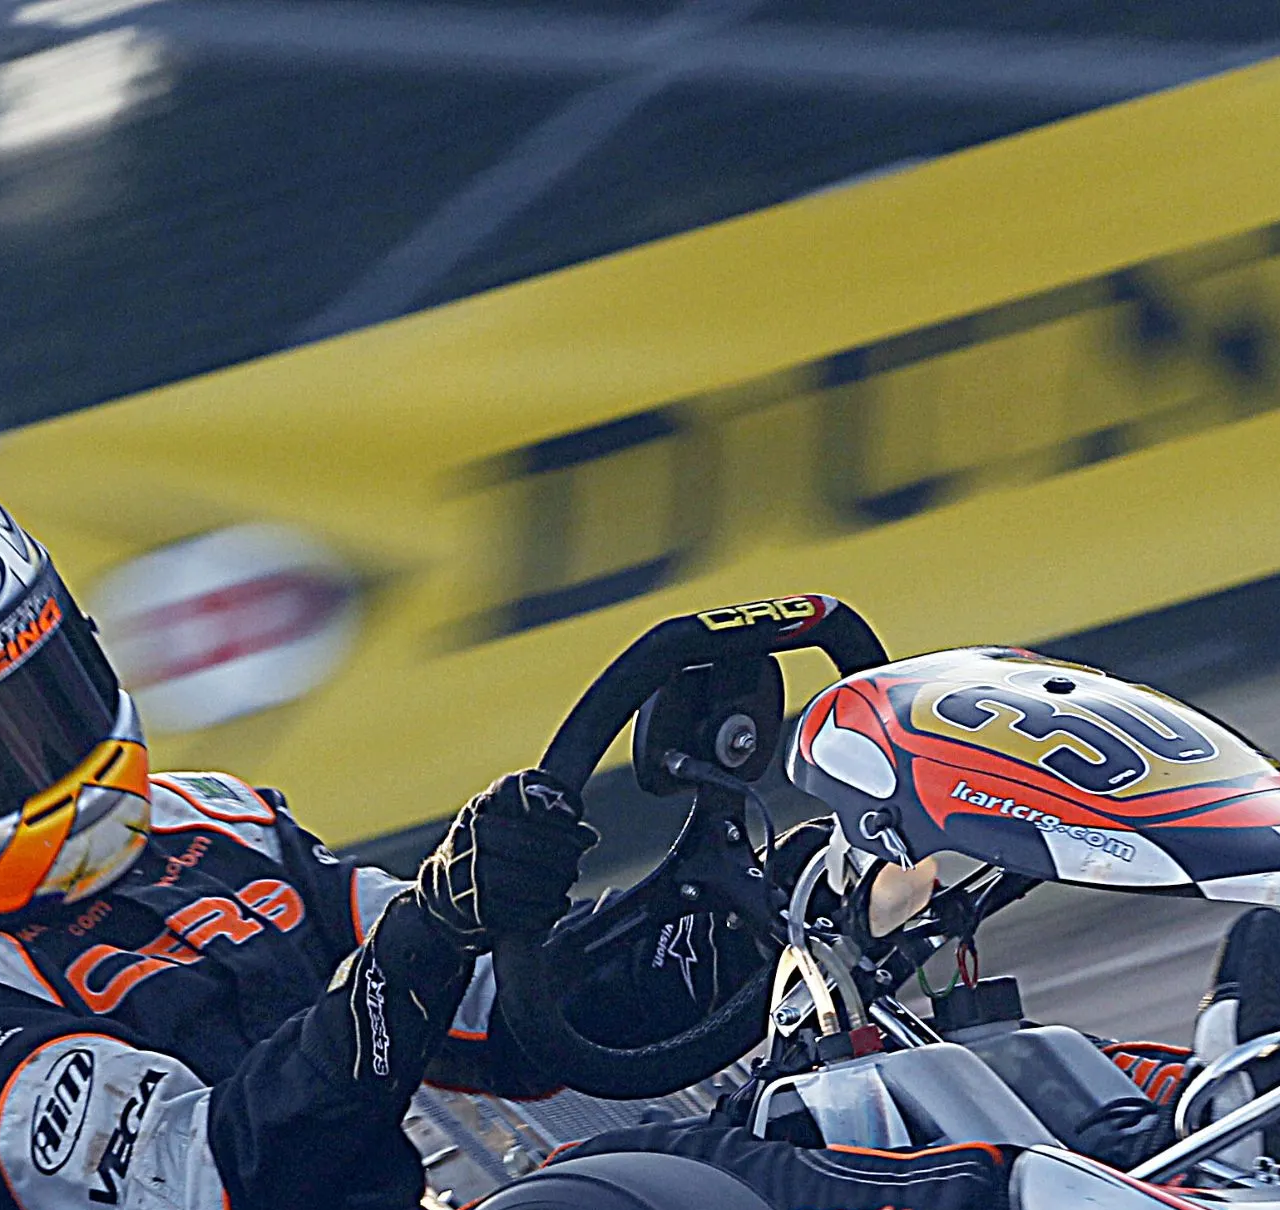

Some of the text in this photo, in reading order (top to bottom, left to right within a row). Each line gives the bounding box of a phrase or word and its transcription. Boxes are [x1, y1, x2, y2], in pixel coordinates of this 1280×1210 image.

[696, 598, 817, 632] CRG
[950, 780, 1137, 863] kartcrg.com
[88, 1068, 169, 1206] VEGA
